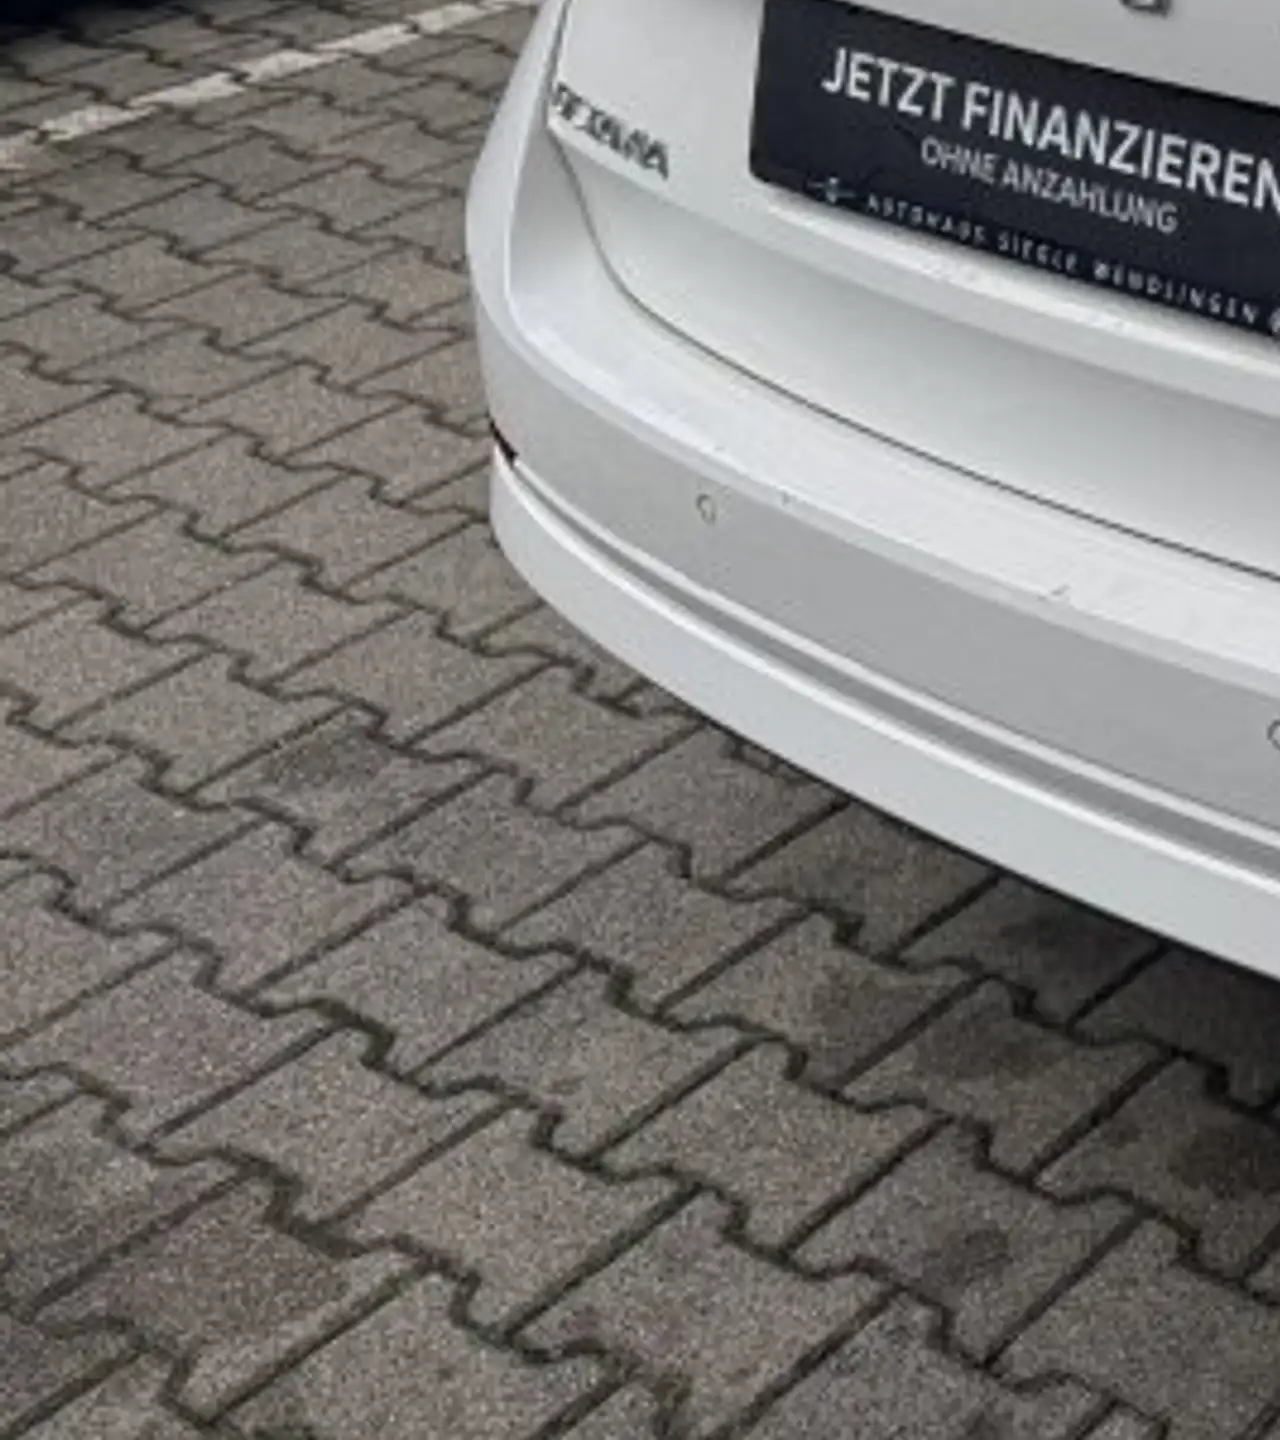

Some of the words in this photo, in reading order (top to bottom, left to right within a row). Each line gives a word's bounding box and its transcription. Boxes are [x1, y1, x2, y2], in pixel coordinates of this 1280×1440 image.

[821, 46, 956, 122] JETZT
[920, 136, 1000, 186] OHNE
[1002, 158, 1179, 235] ANZAHLUNG
